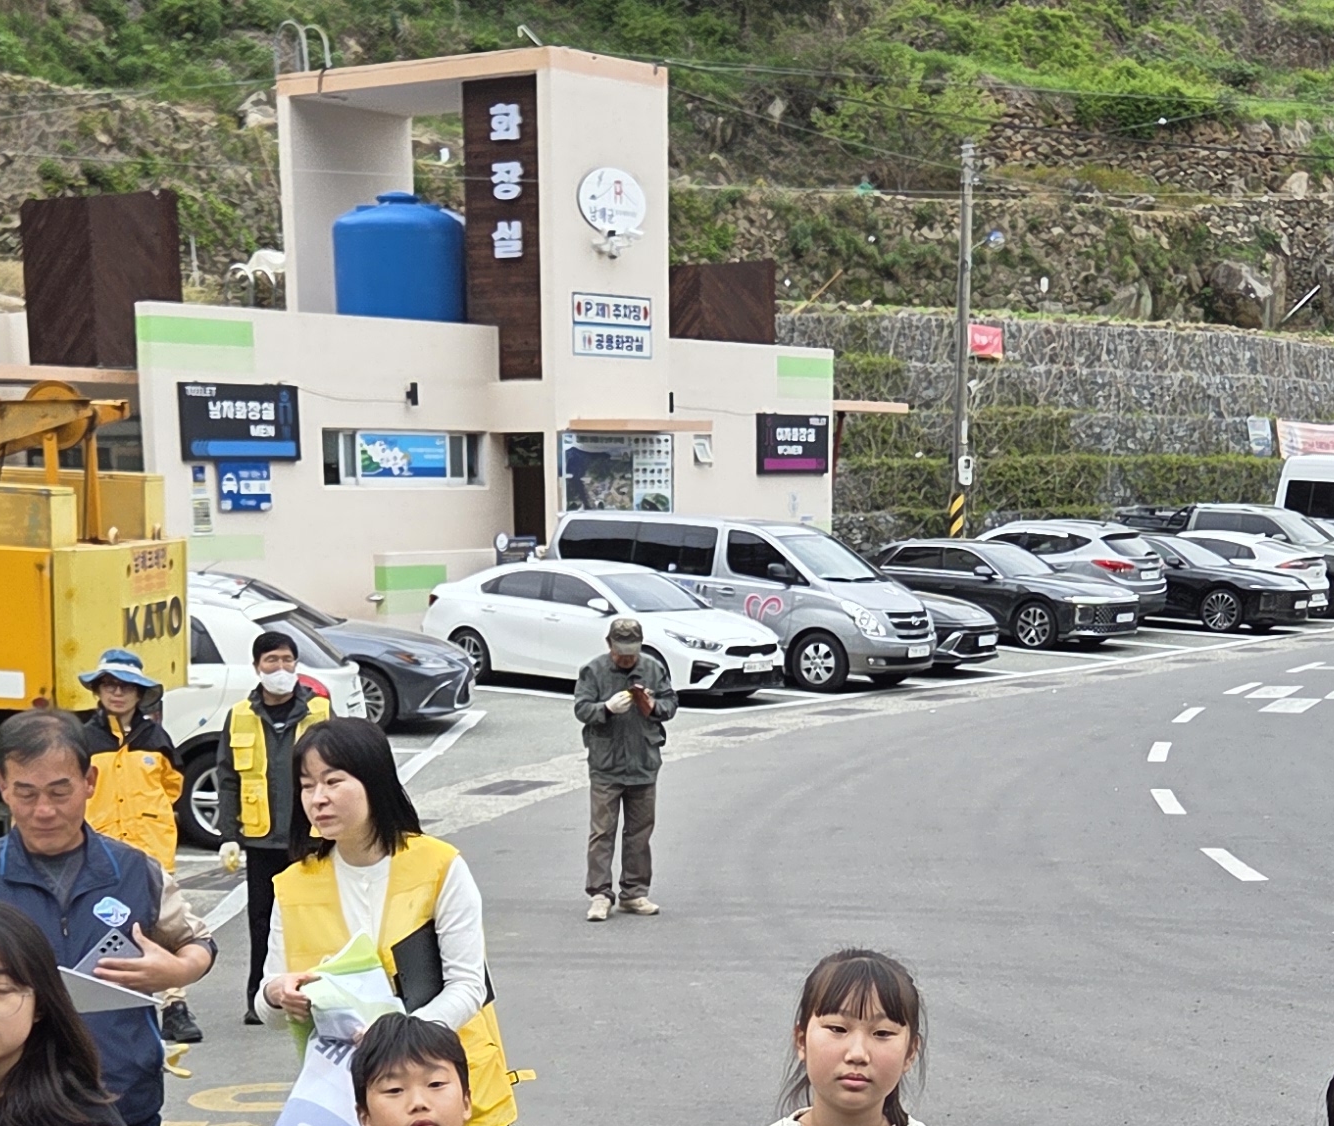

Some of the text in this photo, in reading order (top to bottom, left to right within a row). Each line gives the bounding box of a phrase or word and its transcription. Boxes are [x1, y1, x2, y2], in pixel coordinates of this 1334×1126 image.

[489, 102, 524, 259] 화장실
[612, 303, 642, 322] 주차장
[594, 332, 644, 353] 공용화장실
[207, 399, 275, 421] 남자화장실
[123, 595, 184, 647] KATO
